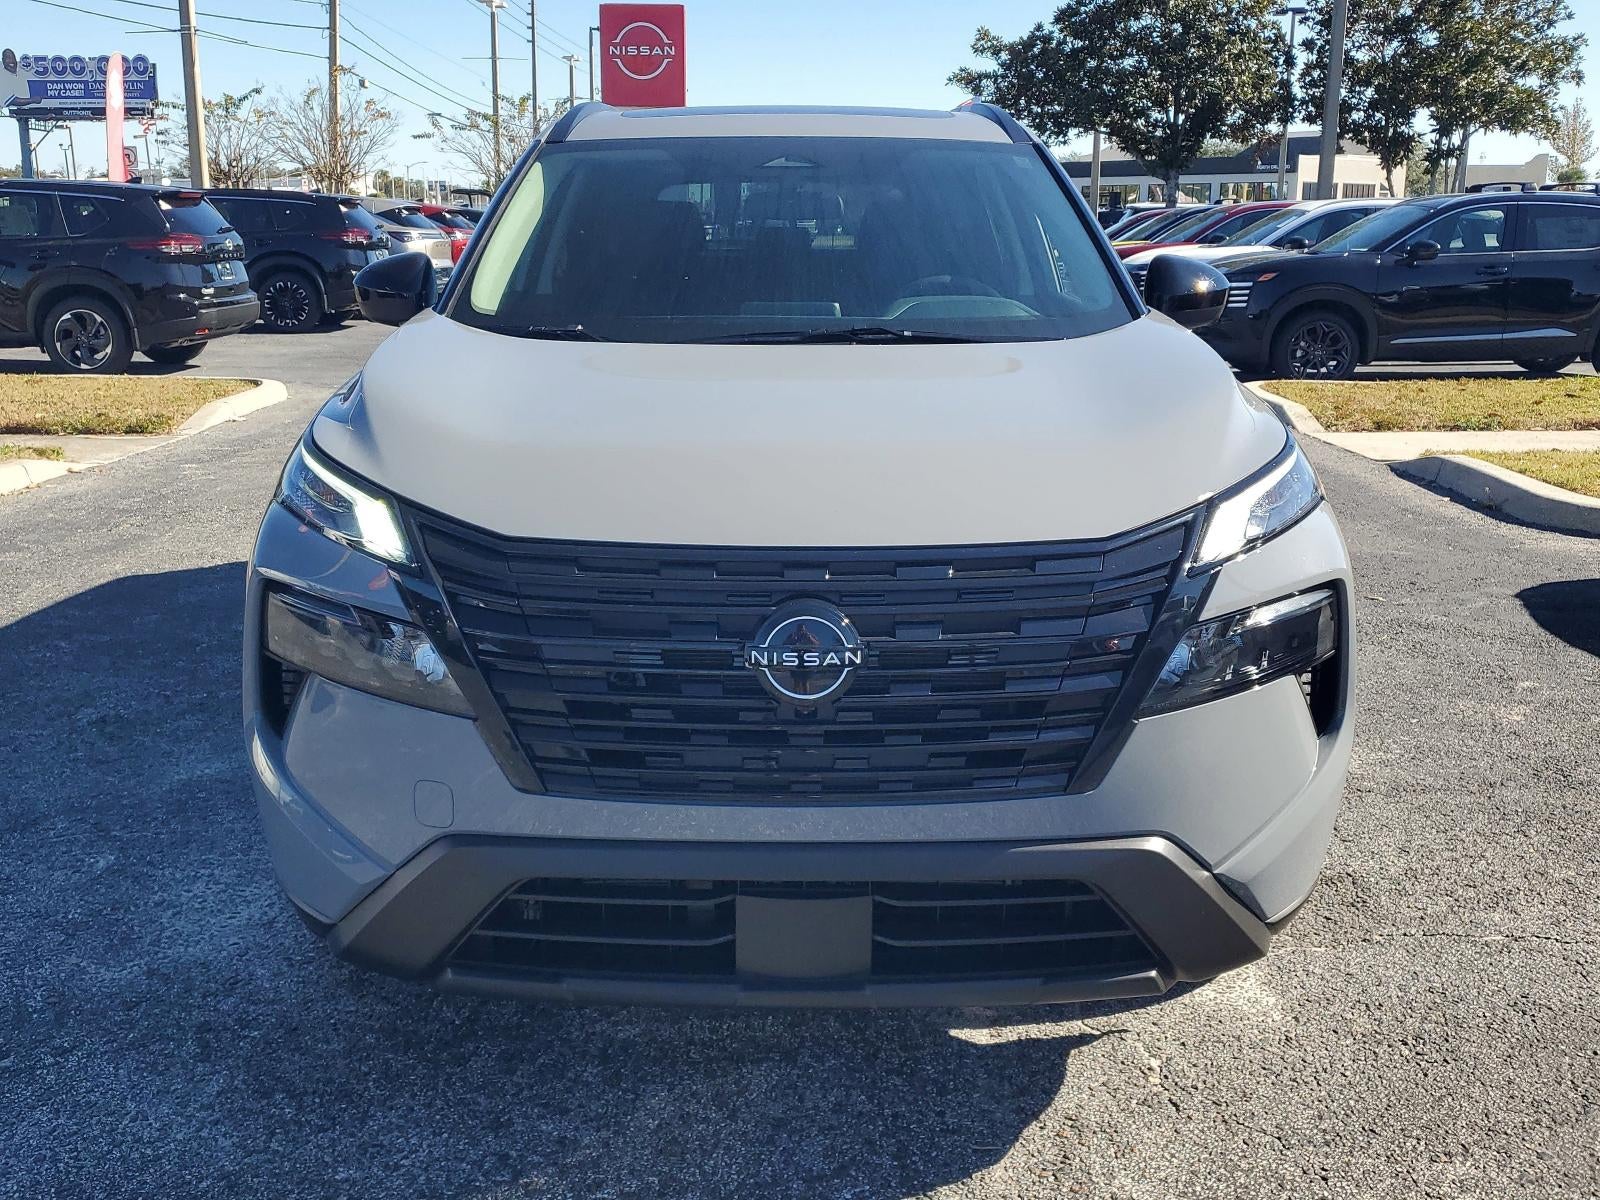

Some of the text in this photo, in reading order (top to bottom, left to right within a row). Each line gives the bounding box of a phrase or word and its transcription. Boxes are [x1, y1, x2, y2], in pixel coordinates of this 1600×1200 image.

[609, 46, 675, 55] NISSAN
[46, 82, 85, 90] DAN WON
[47, 89, 60, 97] MY
[751, 650, 861, 666] NISSAN
